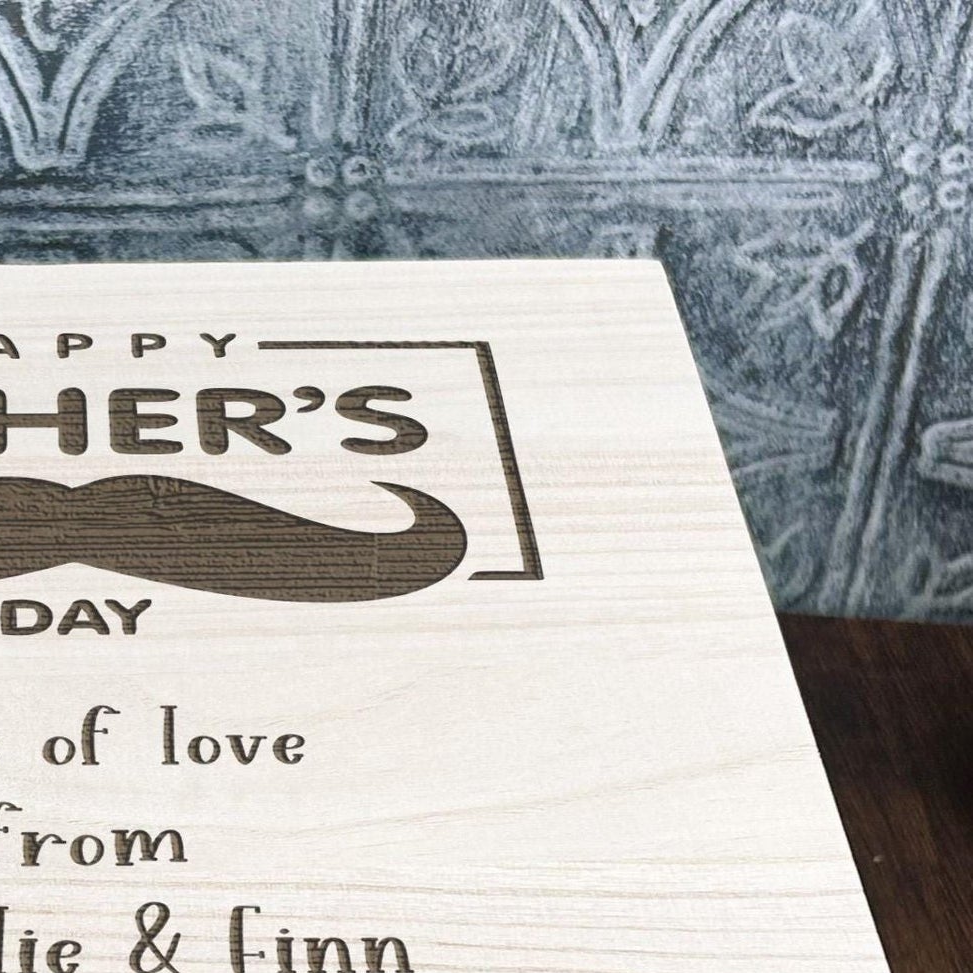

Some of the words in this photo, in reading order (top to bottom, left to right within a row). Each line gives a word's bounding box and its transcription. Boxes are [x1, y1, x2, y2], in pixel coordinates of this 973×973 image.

[0, 598, 152, 636] DAY
[42, 705, 121, 766] of
[160, 705, 306, 766] love
